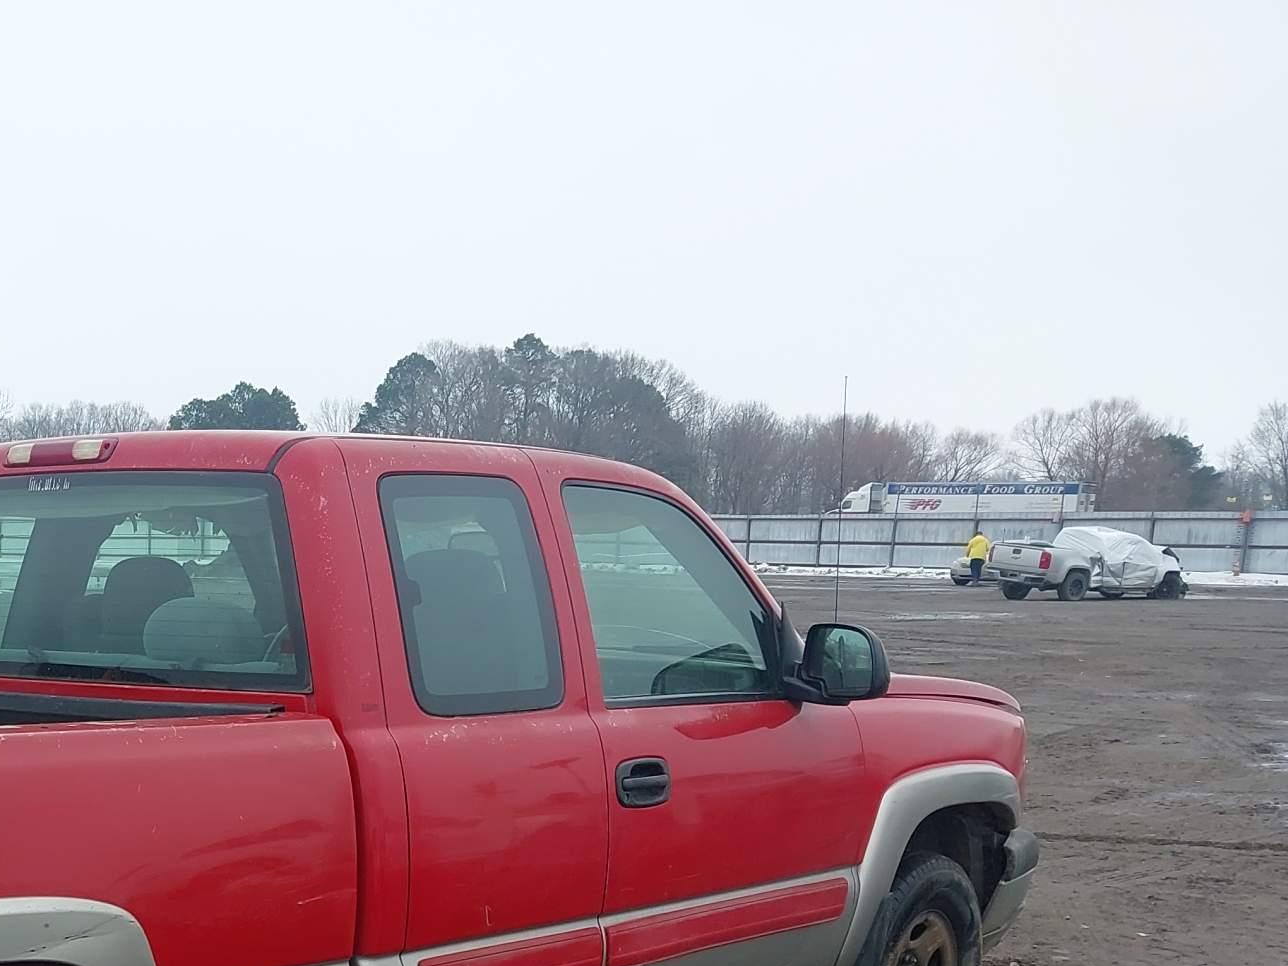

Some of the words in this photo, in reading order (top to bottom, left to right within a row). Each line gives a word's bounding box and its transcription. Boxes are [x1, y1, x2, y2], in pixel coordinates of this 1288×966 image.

[898, 484, 975, 494] PERFORMANCE
[984, 484, 1015, 494] FOOD
[1024, 484, 1065, 494] GROUP
[913, 499, 943, 511] PFG
